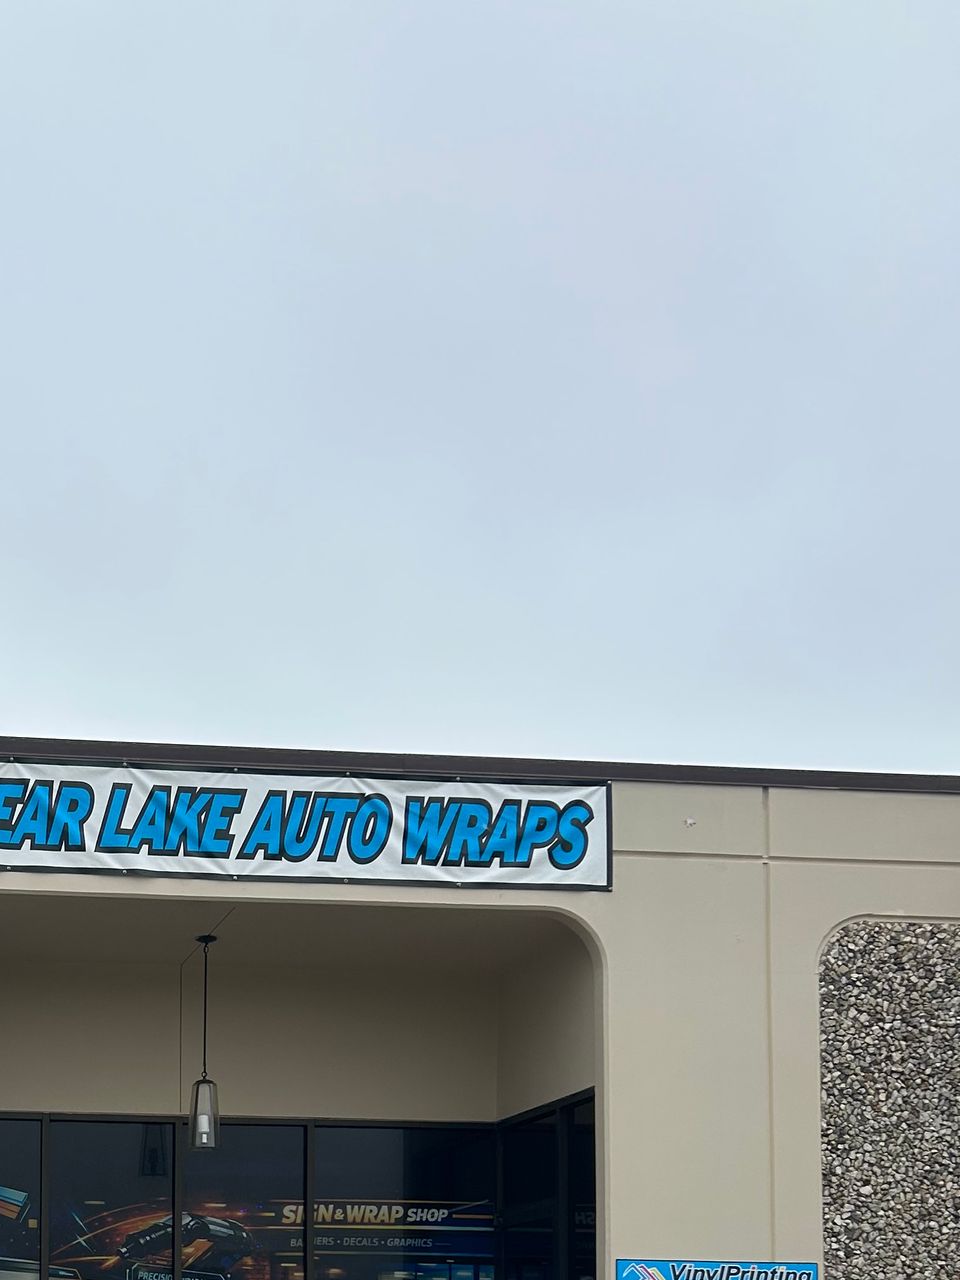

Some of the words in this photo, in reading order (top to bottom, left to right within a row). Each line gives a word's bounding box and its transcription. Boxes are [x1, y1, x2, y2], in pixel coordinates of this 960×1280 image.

[95, 782, 247, 859] LAKE
[236, 790, 394, 865] AUTO
[401, 796, 594, 870] WRAPS
[406, 1207, 449, 1222] SHOP
[290, 1236, 334, 1248] BAERS
[343, 1236, 379, 1248] DECALS
[387, 1237, 433, 1248] GRAPHICS
